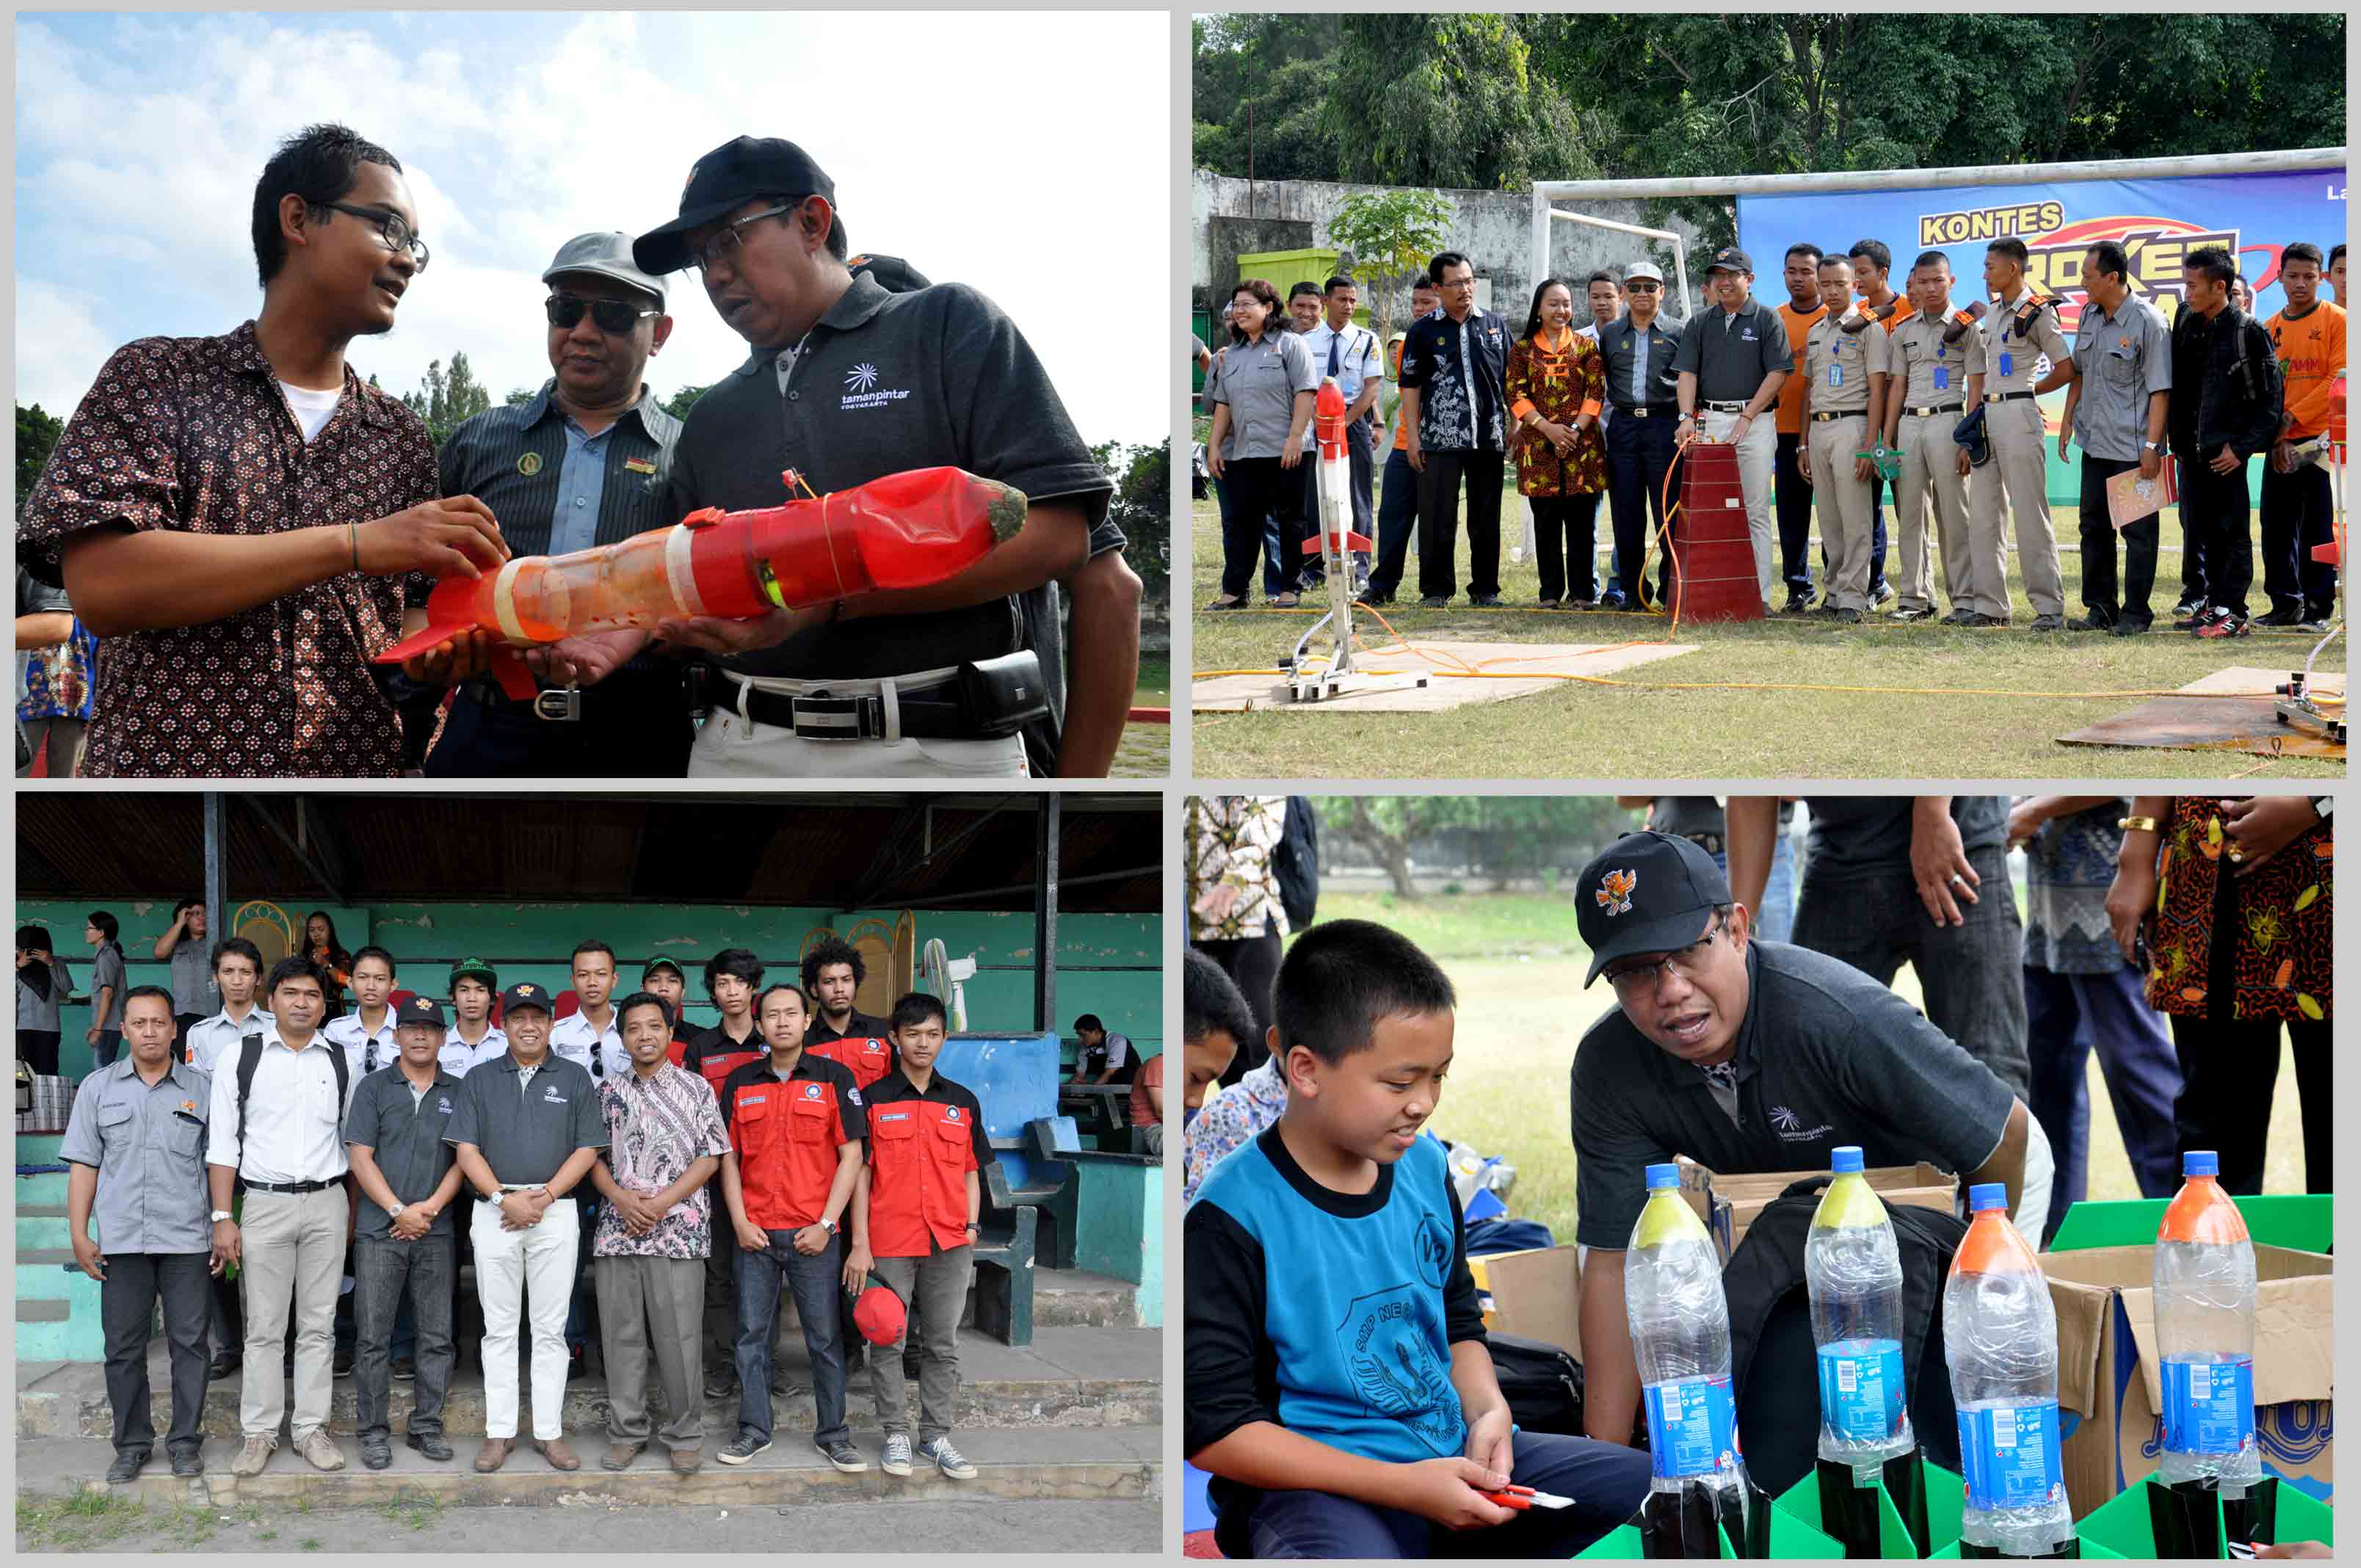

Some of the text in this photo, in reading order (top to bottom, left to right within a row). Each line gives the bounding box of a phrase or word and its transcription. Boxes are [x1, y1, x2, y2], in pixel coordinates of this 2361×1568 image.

[1922, 203, 2061, 244] KONTES
[842, 388, 910, 404] tamanpintar
[1356, 1315, 1376, 1352] SMP
